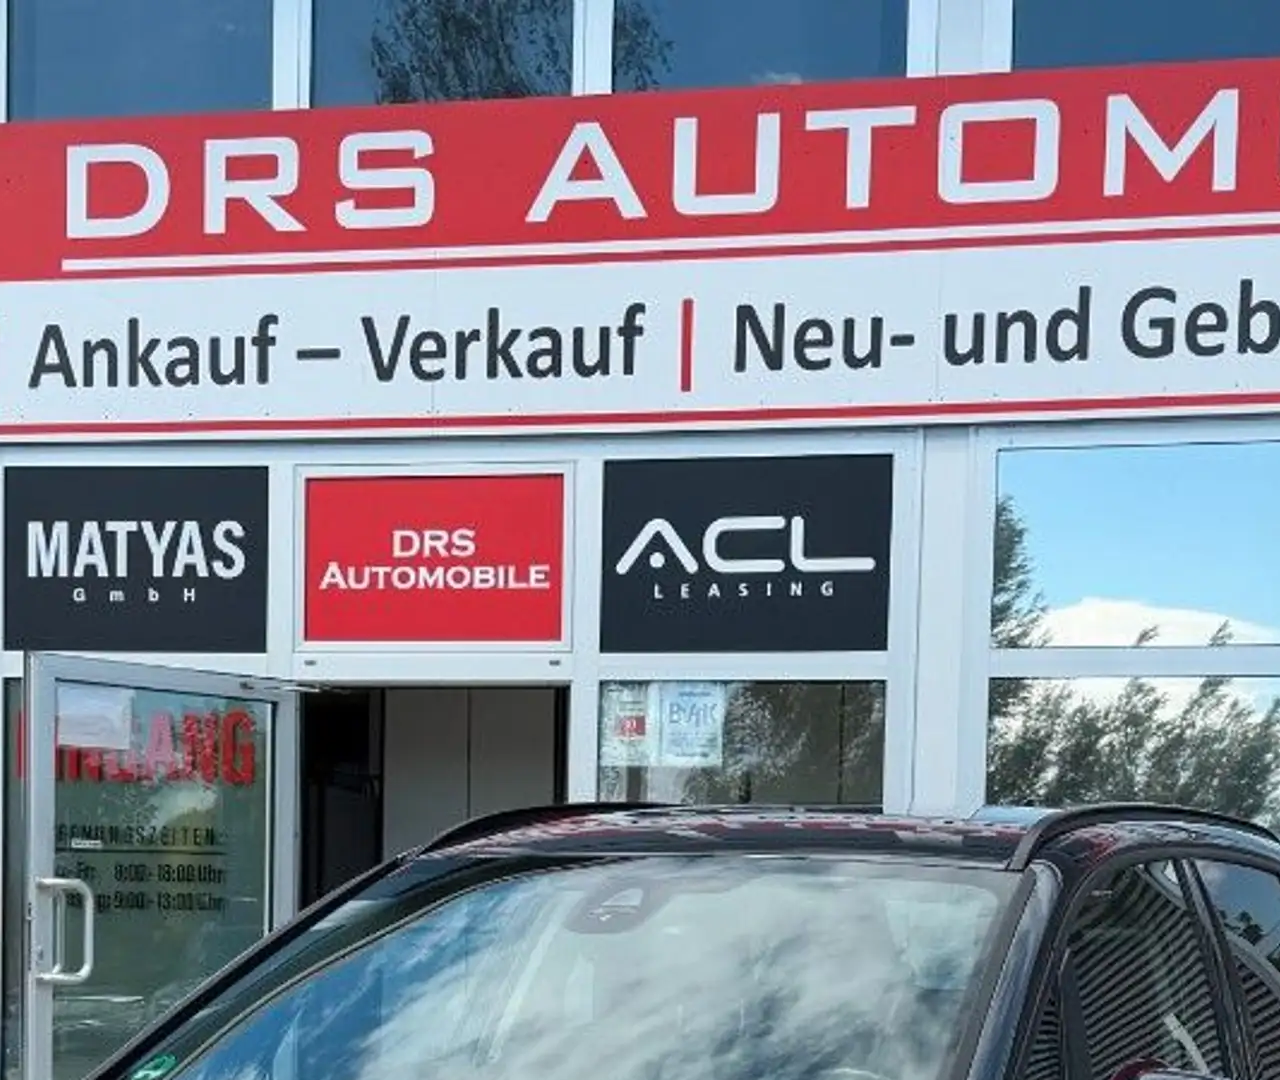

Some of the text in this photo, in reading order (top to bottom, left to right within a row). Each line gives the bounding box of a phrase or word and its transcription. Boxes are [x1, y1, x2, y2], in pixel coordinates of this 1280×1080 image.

[65, 128, 436, 239] DRS
[28, 313, 279, 389] Ankauf
[361, 302, 646, 382] Verkauf
[734, 302, 915, 373] Neu-
[944, 285, 1091, 366] und
[27, 520, 245, 579] MATYAS
[392, 528, 476, 558] DRS
[615, 515, 876, 575] ACL
[319, 560, 551, 590] AUTOMOBILE
[653, 580, 836, 600] LEASING
